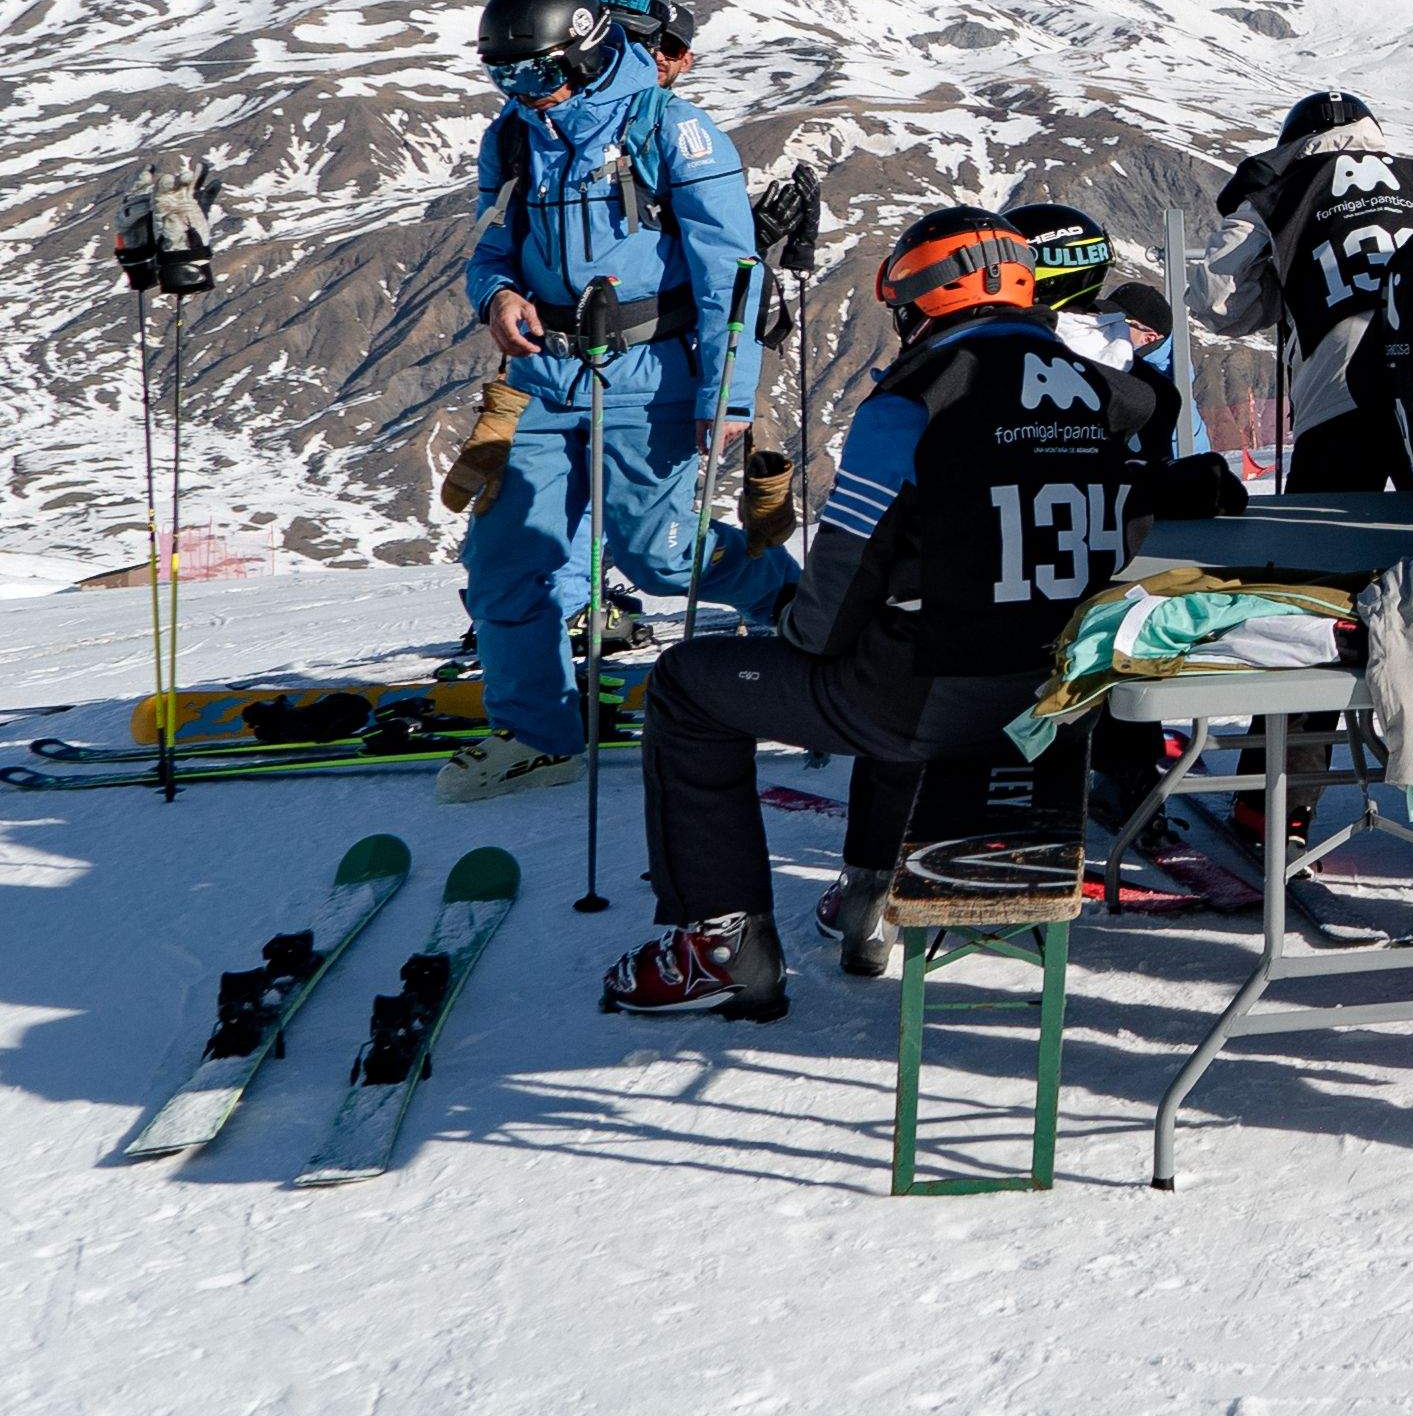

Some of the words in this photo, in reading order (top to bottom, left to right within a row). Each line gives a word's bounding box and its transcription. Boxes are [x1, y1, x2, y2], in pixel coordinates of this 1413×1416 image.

[1025, 225, 1084, 244] HEAD
[1042, 242, 1110, 266] ULLER
[990, 483, 1132, 603] 134
